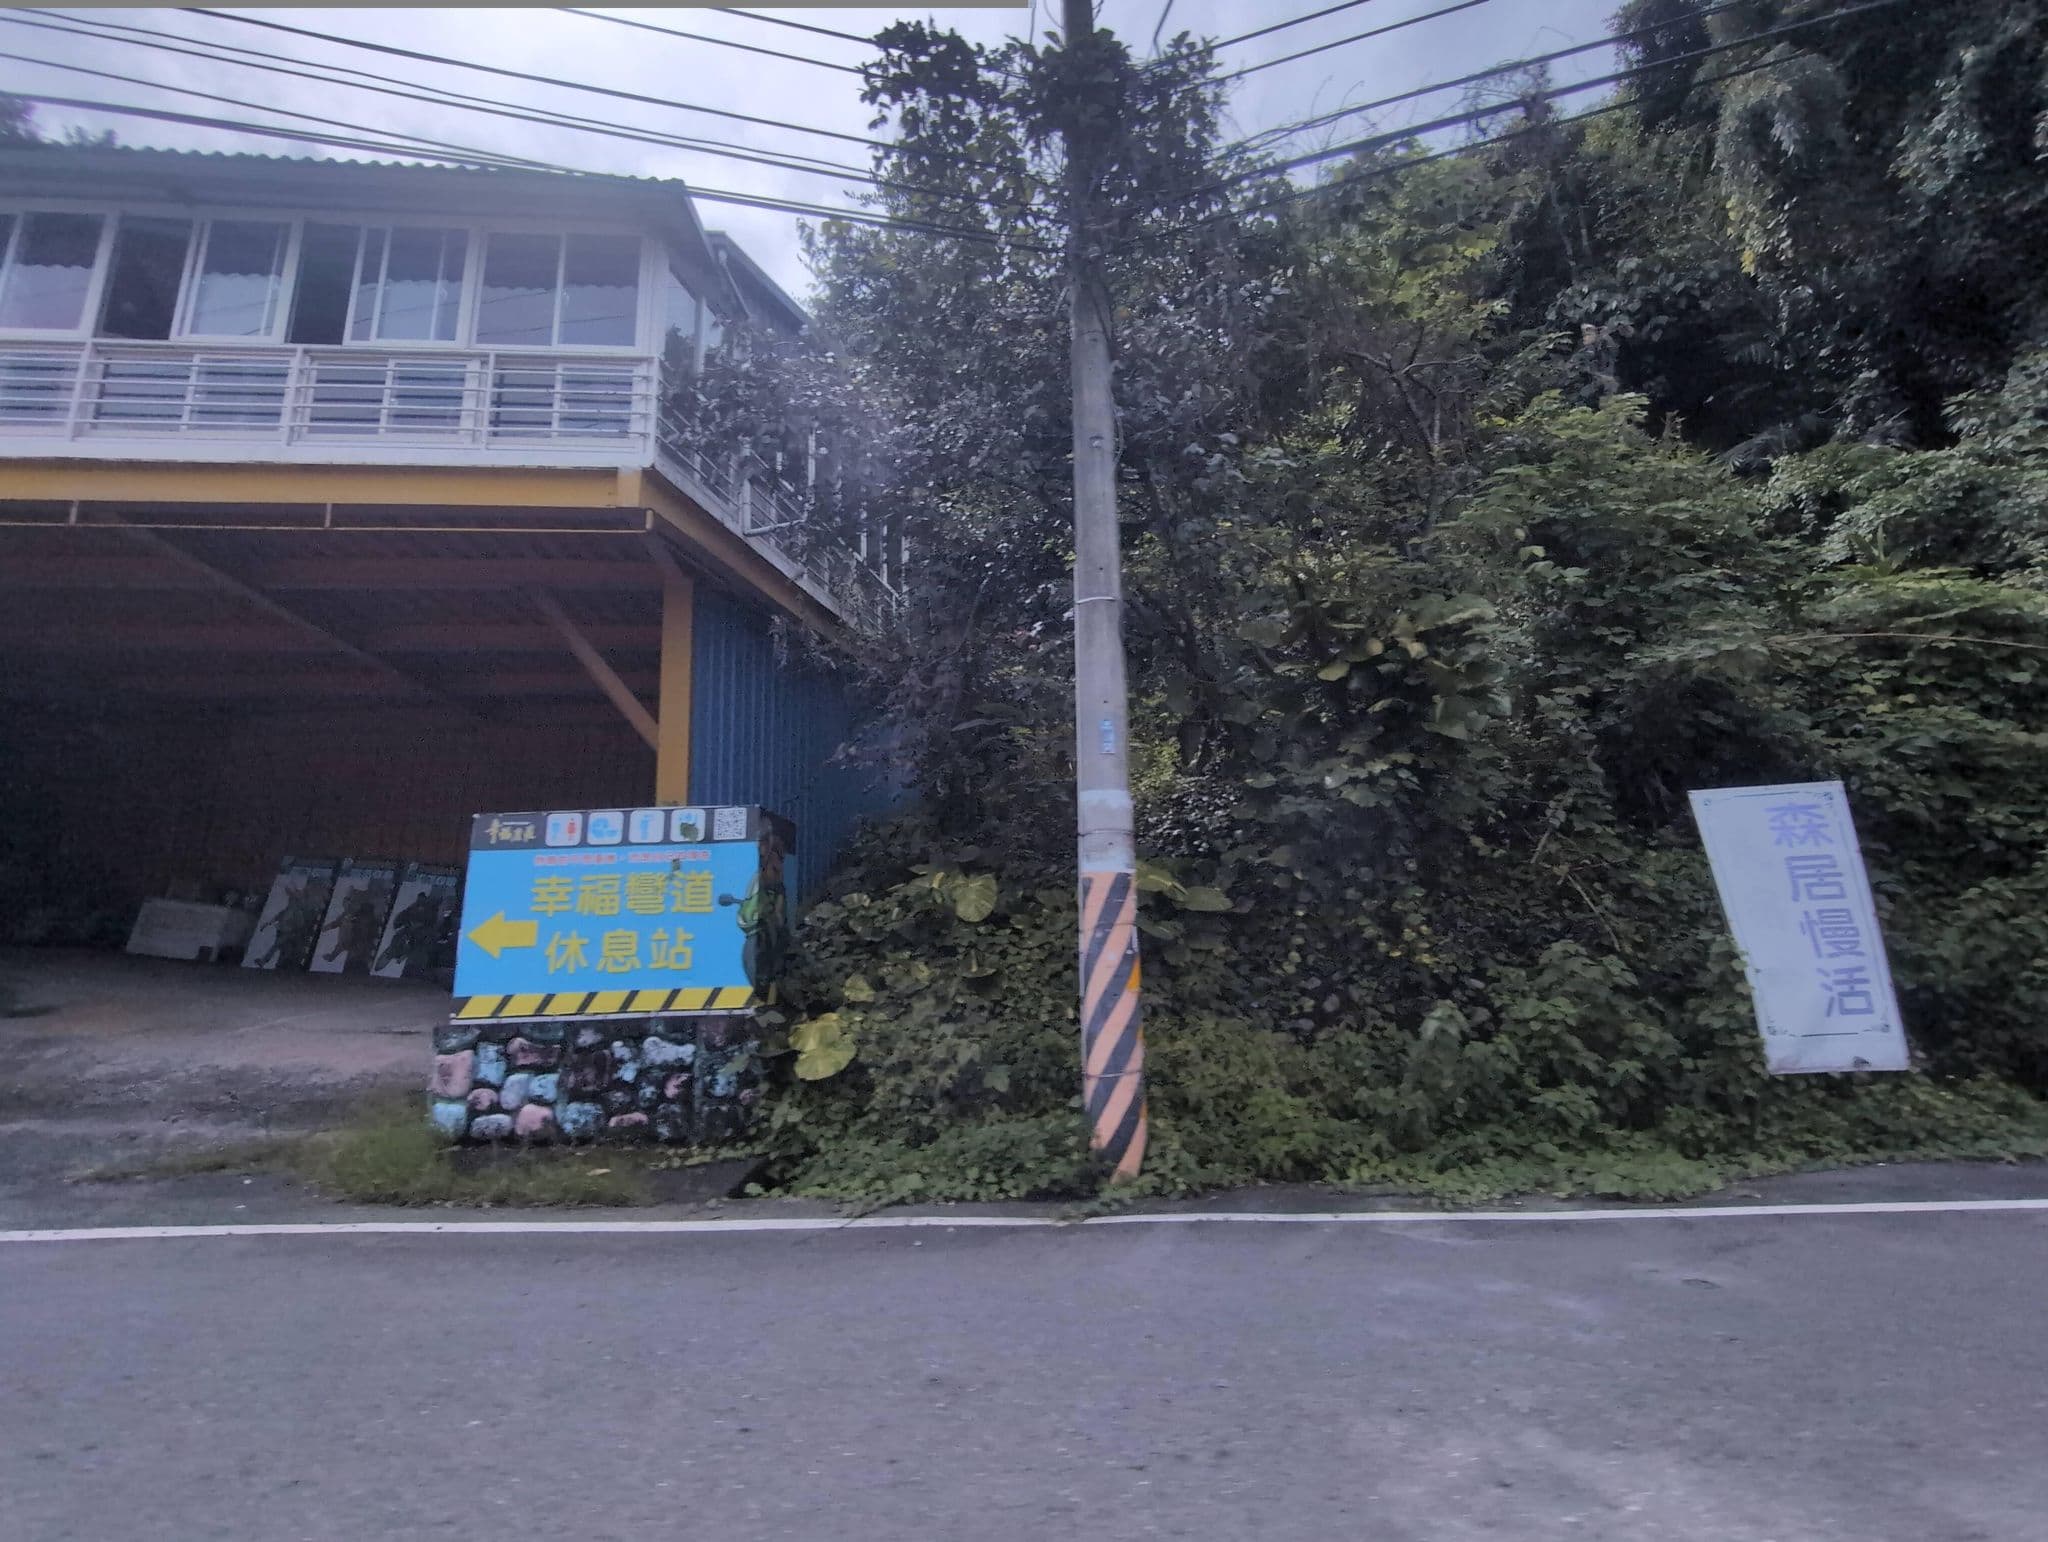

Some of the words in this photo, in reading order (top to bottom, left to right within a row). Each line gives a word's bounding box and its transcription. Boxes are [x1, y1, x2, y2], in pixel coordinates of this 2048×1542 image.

[530, 871, 714, 917] 幸福彎道
[1765, 802, 1875, 1017] 森居慢活
[544, 927, 695, 974] 休息站
